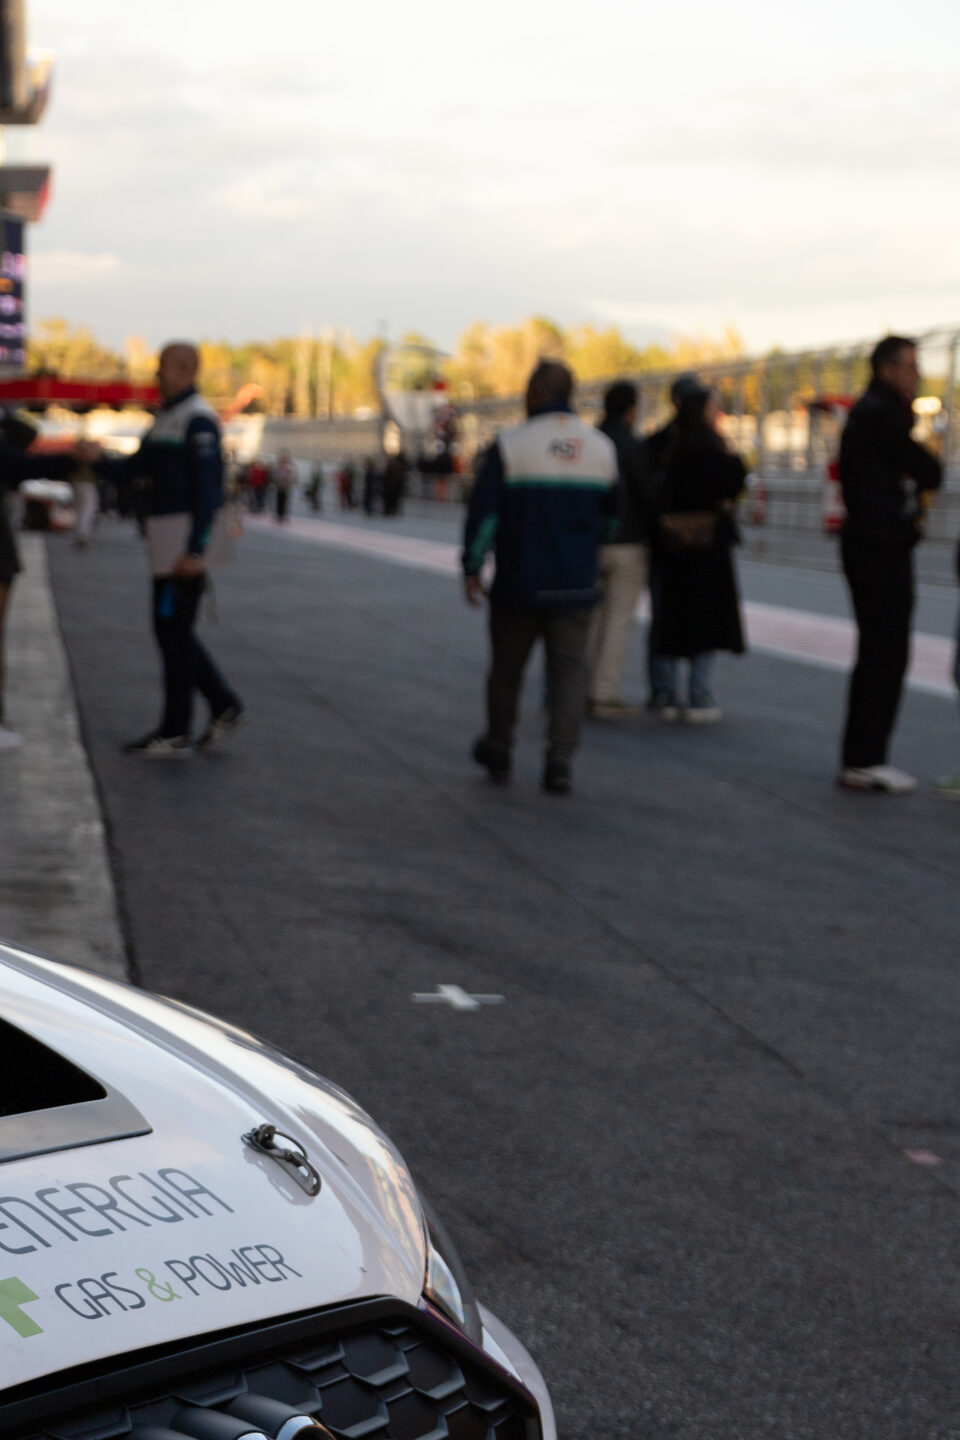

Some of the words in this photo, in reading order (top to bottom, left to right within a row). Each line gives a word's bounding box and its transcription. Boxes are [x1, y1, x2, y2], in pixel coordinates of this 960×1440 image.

[54, 1271, 147, 1320] GAS
[134, 1267, 182, 1303] &
[163, 1243, 303, 1297] POWER
